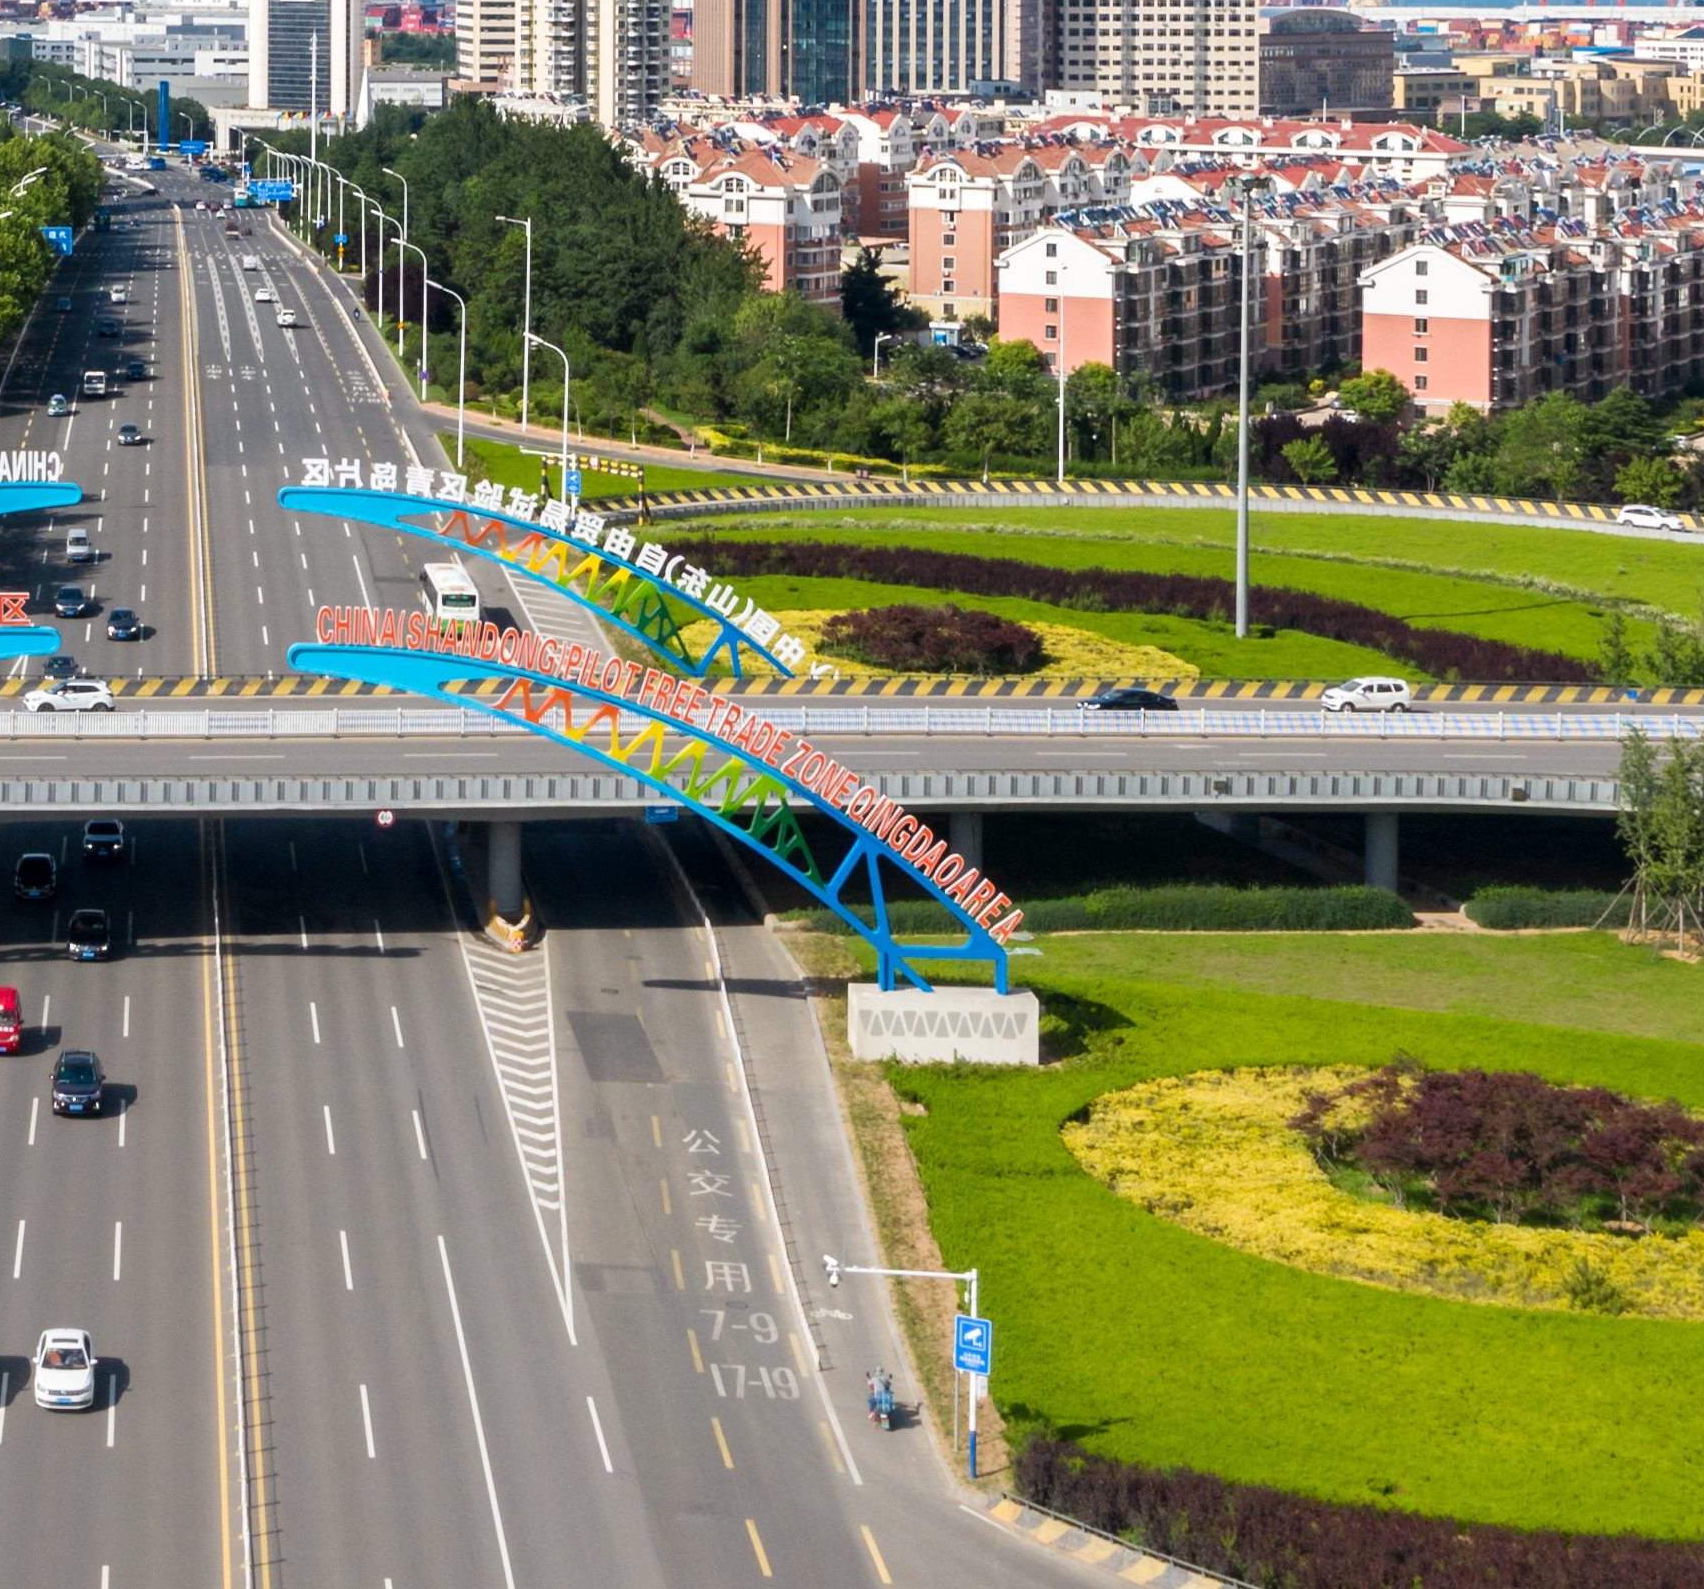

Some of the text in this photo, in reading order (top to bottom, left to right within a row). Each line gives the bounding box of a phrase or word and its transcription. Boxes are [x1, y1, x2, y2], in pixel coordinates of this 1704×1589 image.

[637, 668, 707, 725] FREE
[706, 696, 792, 766] TRADE
[780, 740, 859, 809] ZONE
[682, 1129, 752, 1293] 公交专用
[699, 1310, 779, 1344] 7-9
[710, 1363, 800, 1399] 17-19
